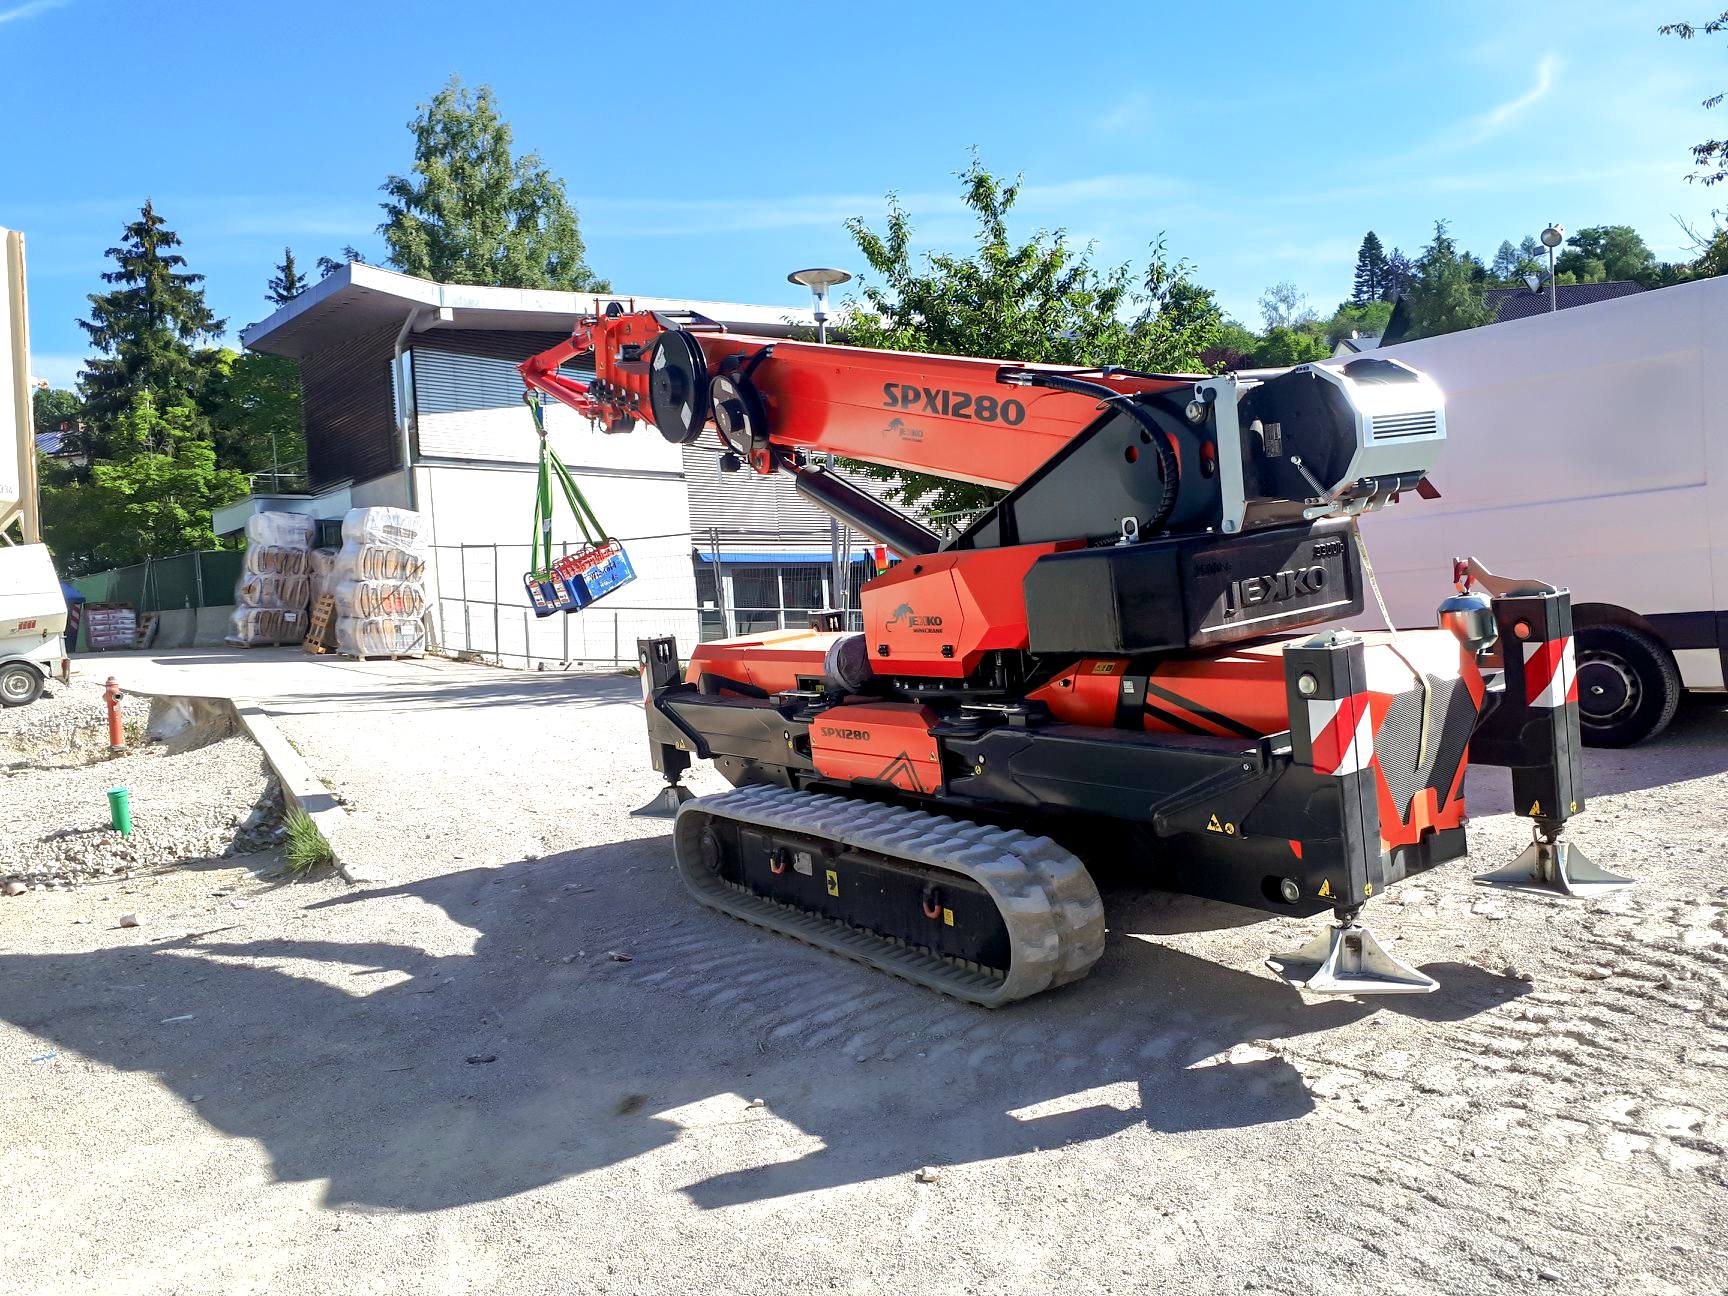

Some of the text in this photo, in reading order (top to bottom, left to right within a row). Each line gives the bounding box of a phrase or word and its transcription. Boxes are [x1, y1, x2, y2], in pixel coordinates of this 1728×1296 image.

[883, 382, 1026, 425] SPX1280
[1223, 565, 1329, 618] JEKKO
[909, 615, 942, 628] JEKKO
[820, 726, 871, 742] SPX1280
